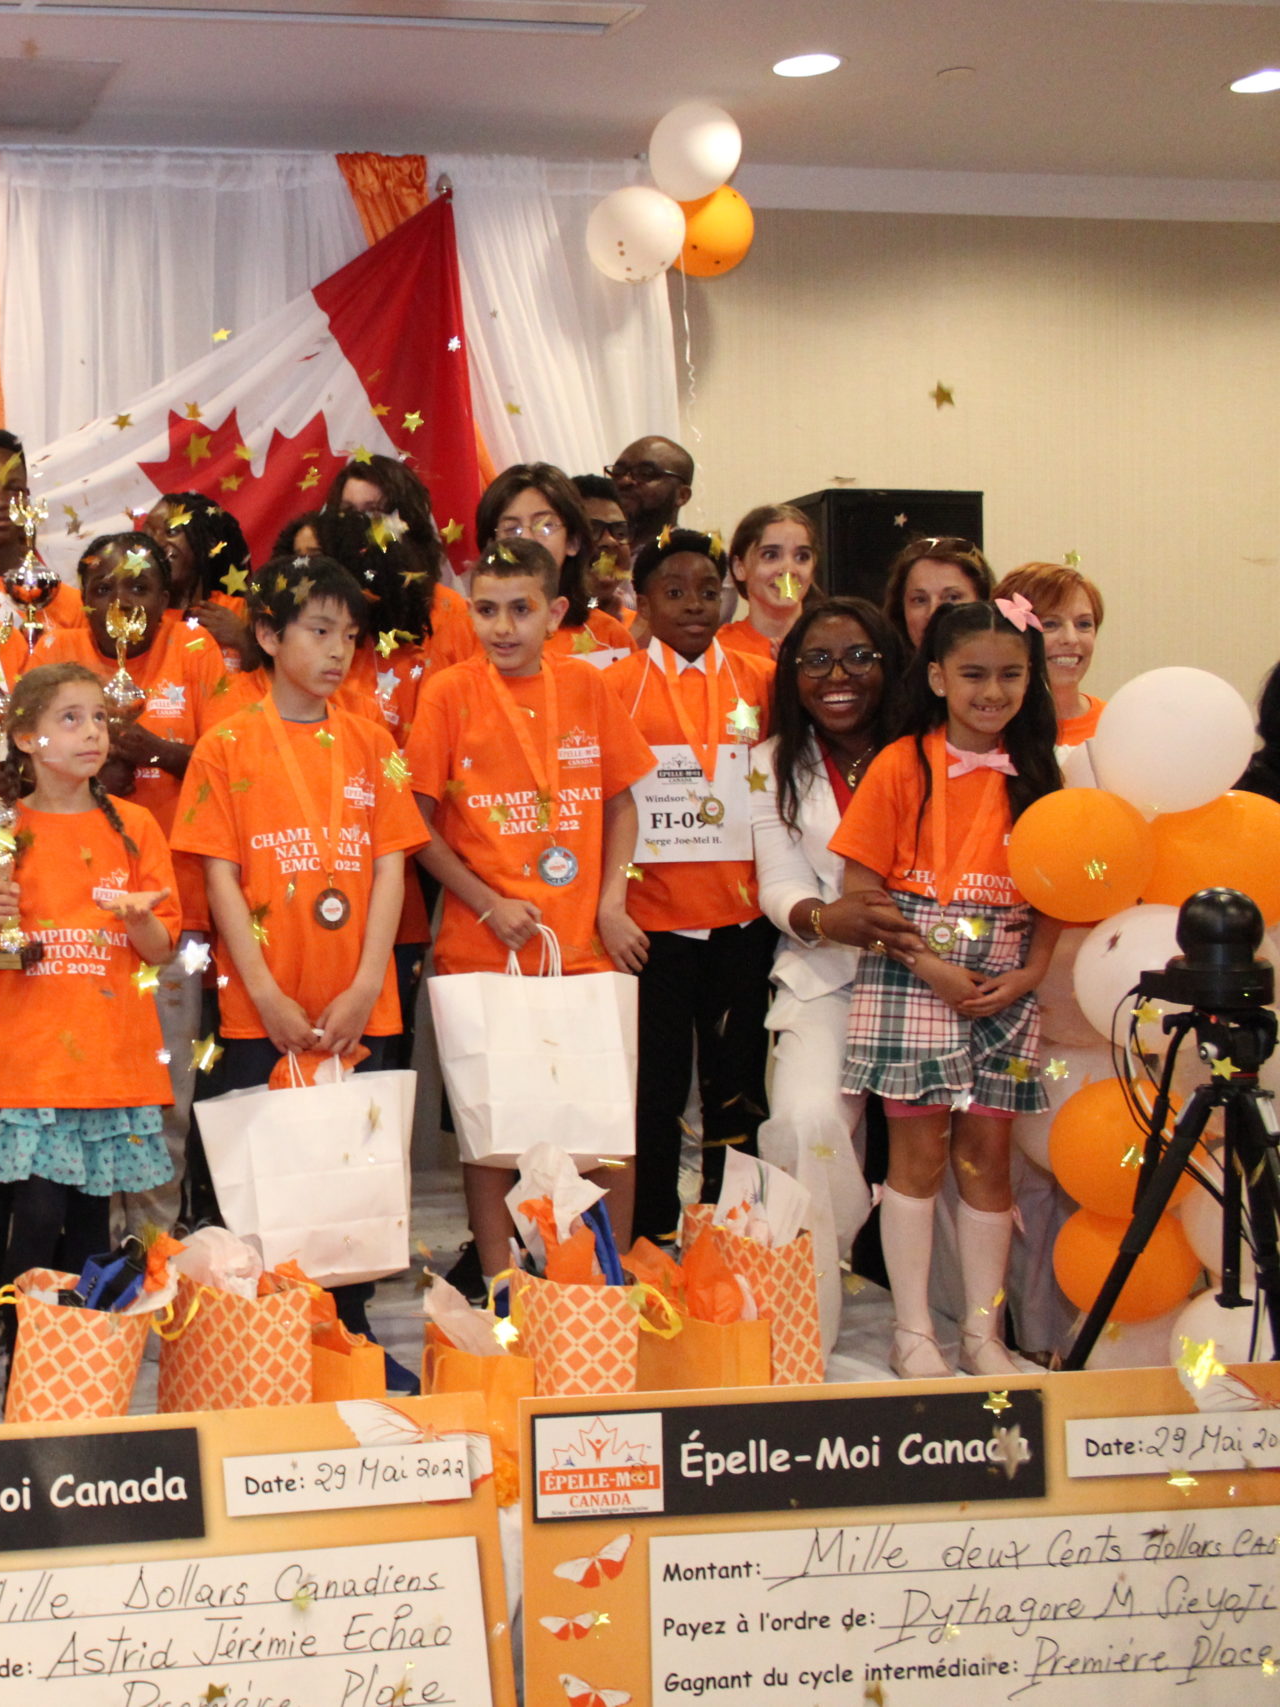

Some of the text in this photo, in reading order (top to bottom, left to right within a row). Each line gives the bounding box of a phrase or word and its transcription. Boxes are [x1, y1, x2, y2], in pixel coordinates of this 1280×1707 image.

[66, 961, 107, 977] 2022
[680, 1430, 880, 1487] Épelle-Moi
[1085, 1437, 1144, 1457] Date:
[1146, 1426, 1187, 1457] 29
[1189, 1424, 1243, 1460] Mai
[50, 1466, 188, 1508] Canada
[244, 1456, 465, 1496] Date: 29 Mai 2022
[569, 1492, 632, 1508] CANADA
[662, 1560, 762, 1583] Montant:
[768, 1522, 910, 1591] Mille
[941, 1526, 1031, 1570] deux
[1046, 1525, 1122, 1568] Cents
[274, 1563, 440, 1602] Canadiens
[663, 1616, 727, 1643] Payez
[736, 1613, 750, 1633] à
[759, 1609, 832, 1633] l'ordre
[840, 1608, 876, 1631] de:
[44, 1626, 178, 1682] Astrid
[664, 1669, 753, 1697] Gagnant
[763, 1666, 789, 1687] du
[798, 1663, 854, 1690] cycle
[865, 1656, 1019, 1683] intermédiaire:
